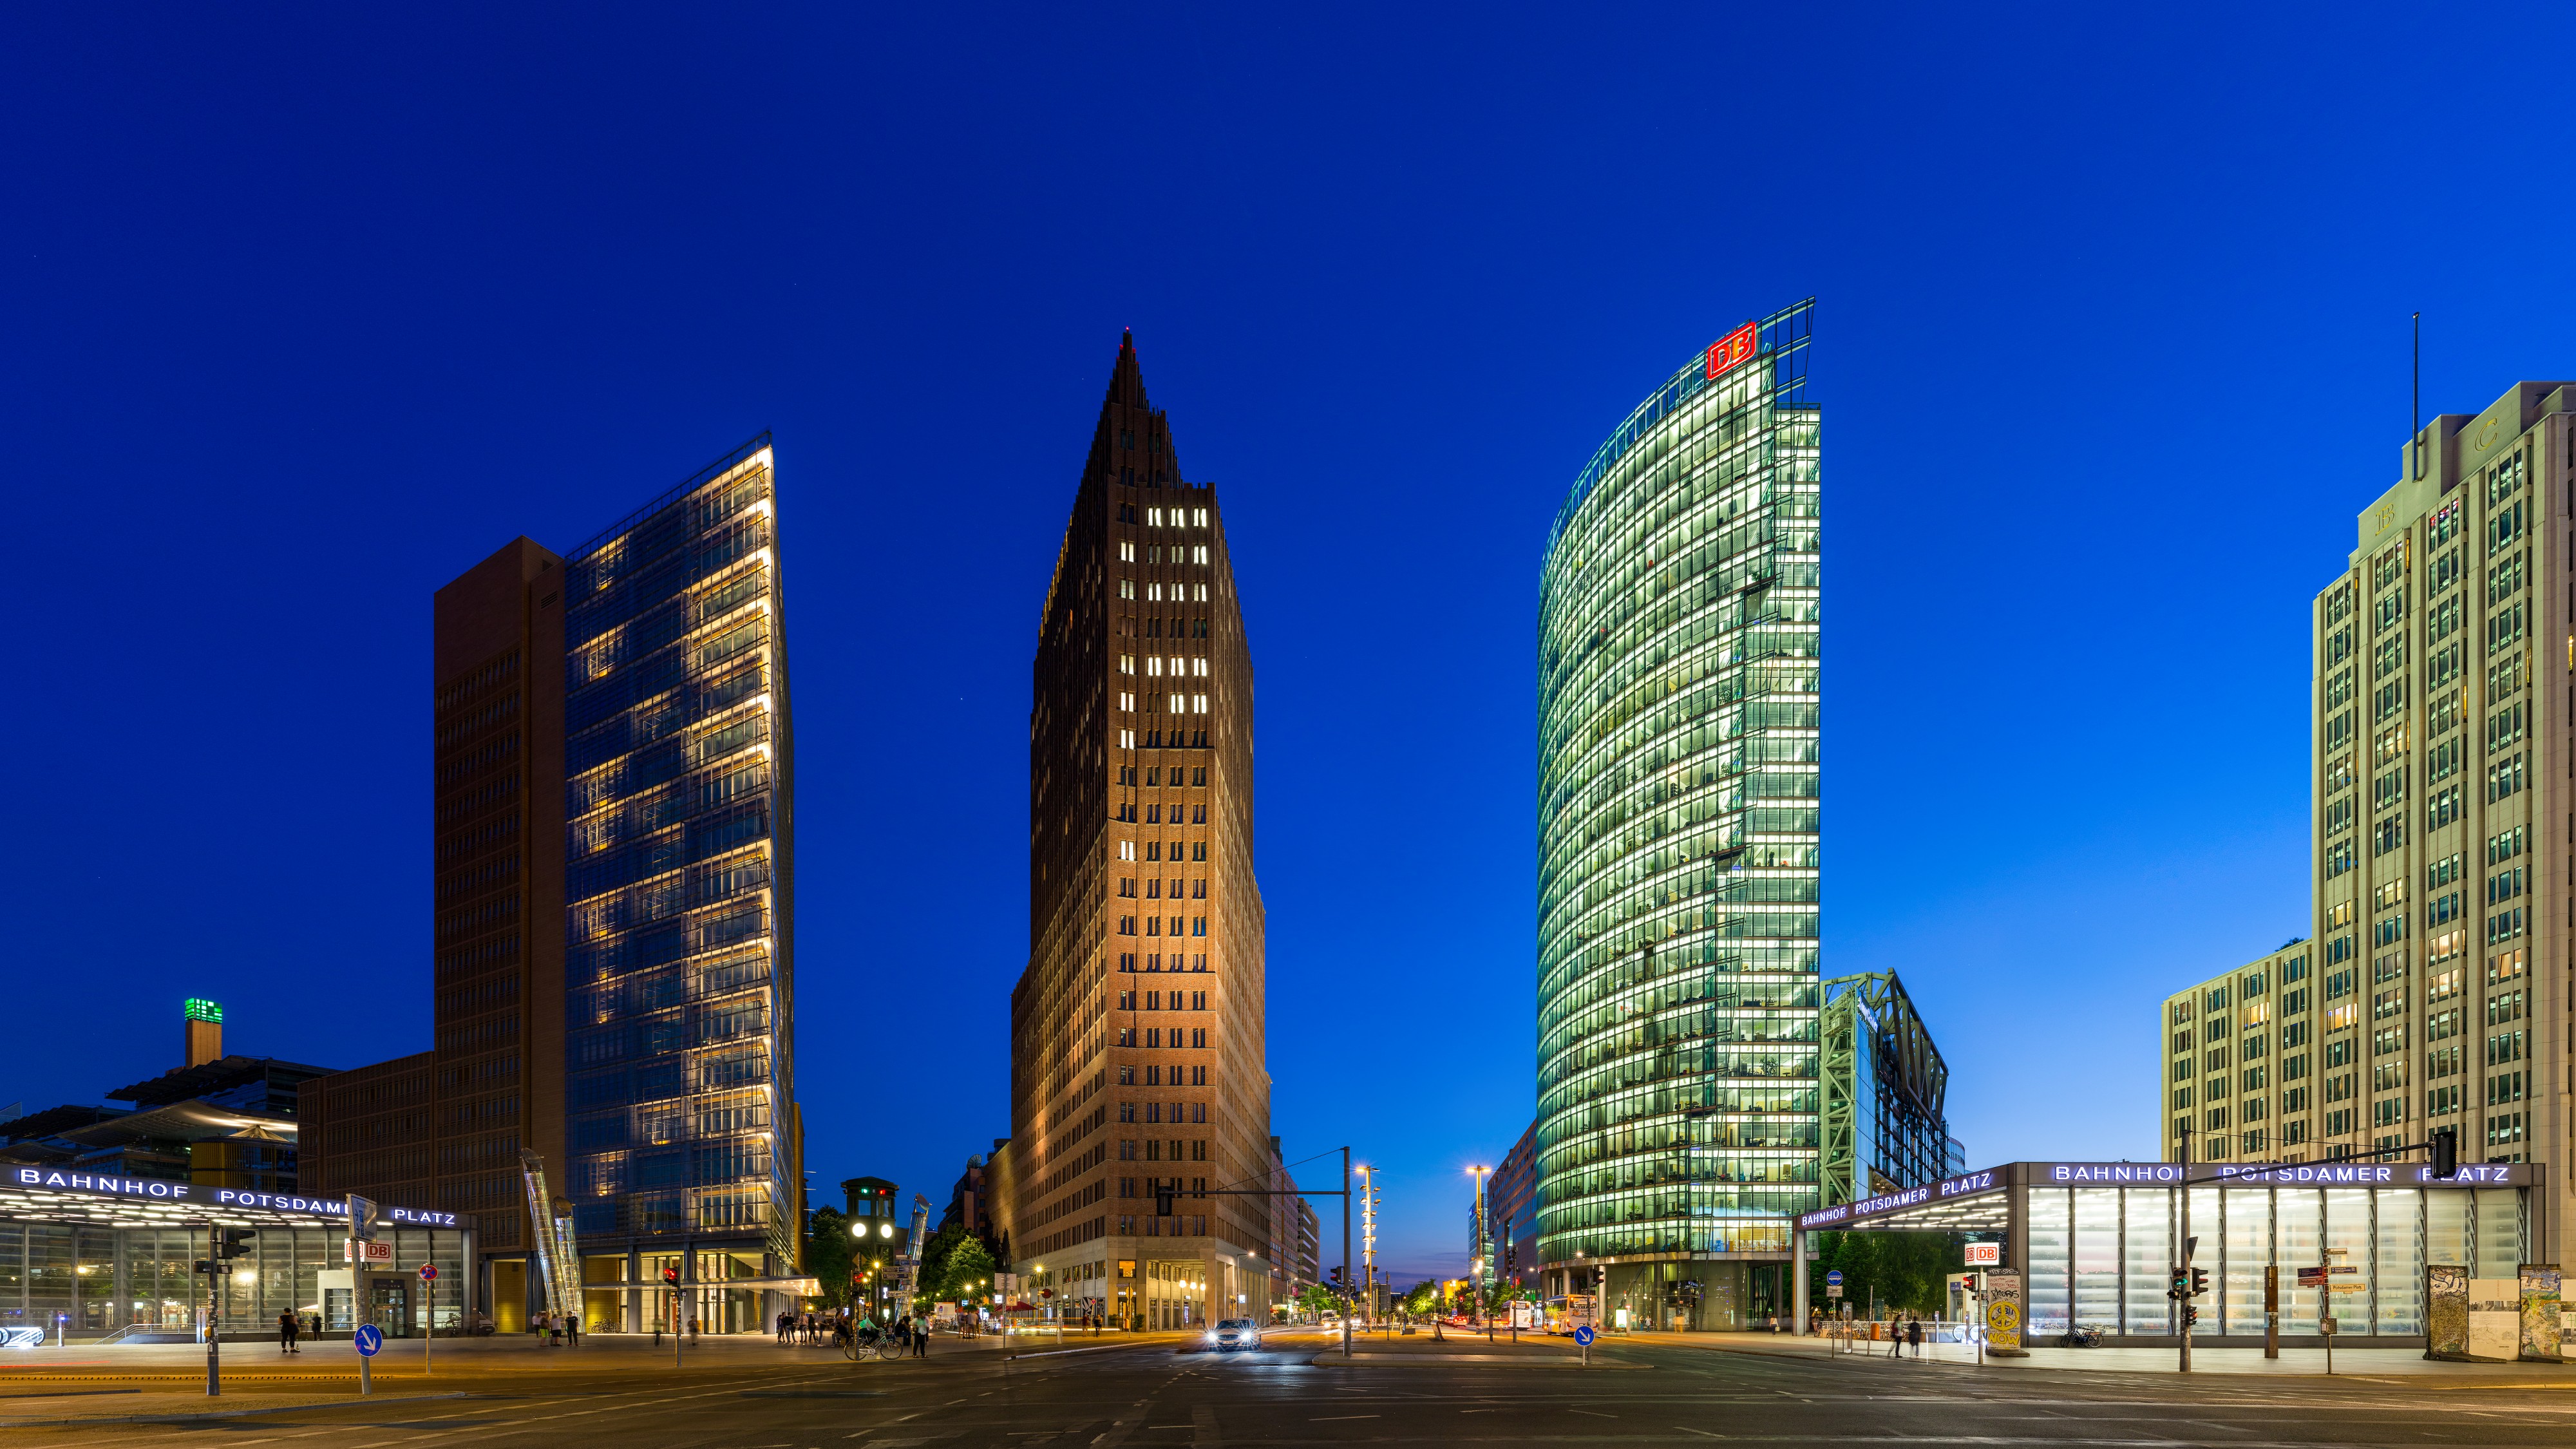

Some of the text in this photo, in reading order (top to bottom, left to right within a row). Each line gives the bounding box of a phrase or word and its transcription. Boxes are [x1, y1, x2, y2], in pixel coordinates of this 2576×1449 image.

[1713, 332, 1750, 374] DB
[2222, 1167, 2391, 1181] POTSDAMER
[20, 1169, 455, 1225] BAHNHOF POTSDAM PLATZ
[1802, 1173, 1991, 1226] BAHNHOF POTSDAMER PLATZ
[369, 1245, 388, 1256] DB
[1966, 1250, 1973, 1259] DB
[1979, 1249, 1995, 1258] DB
[1988, 1332, 2020, 1345] NOW
